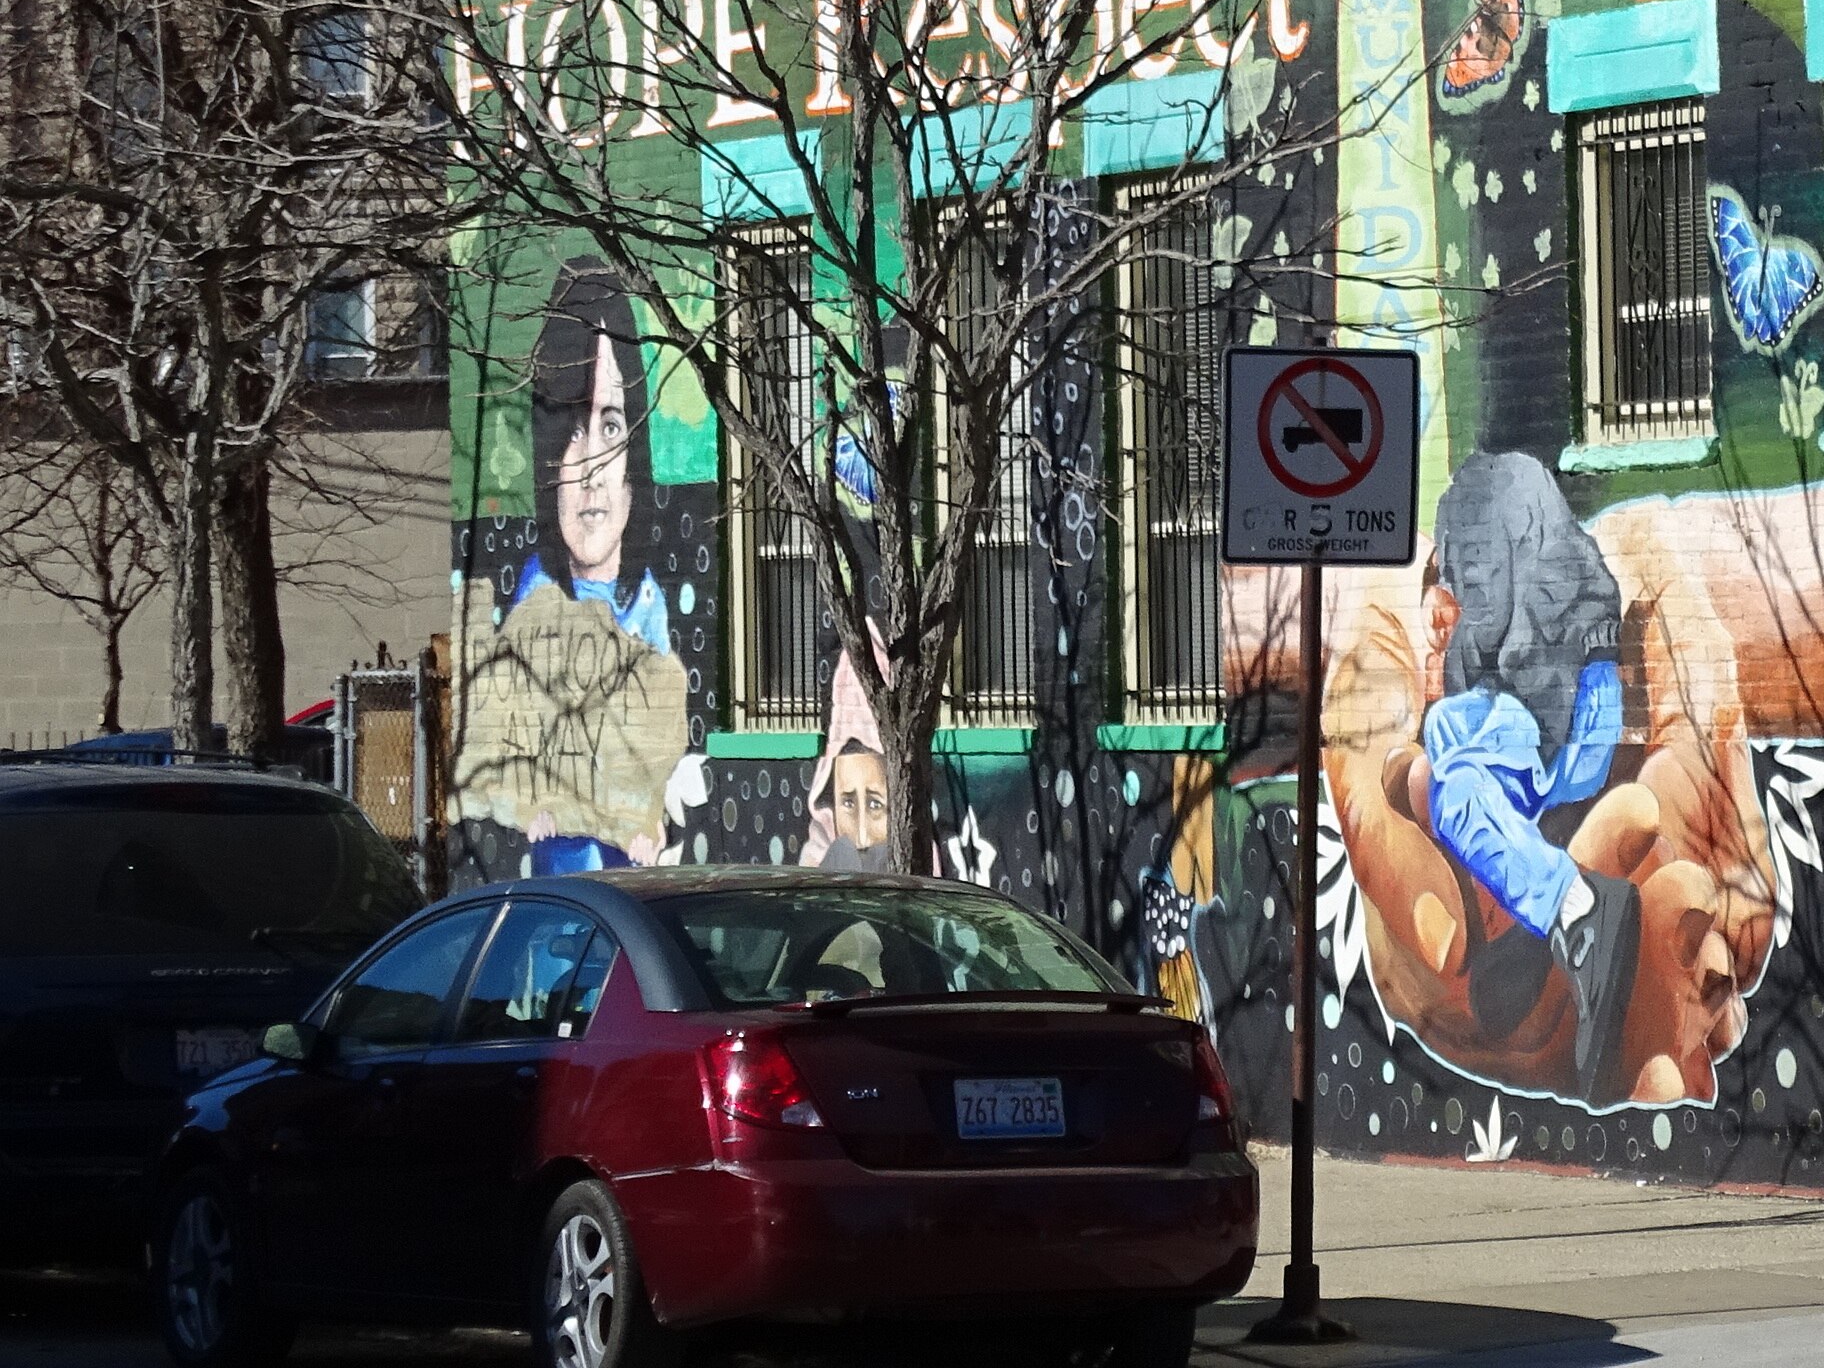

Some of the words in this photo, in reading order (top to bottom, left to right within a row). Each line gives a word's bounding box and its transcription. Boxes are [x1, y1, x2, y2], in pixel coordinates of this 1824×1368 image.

[1310, 505, 1333, 536] 5
[1346, 510, 1395, 532] TONS
[1268, 538, 1313, 552] GROSS
[1320, 539, 1369, 552] WEIGHT
[1011, 1096, 1060, 1125] 2835
